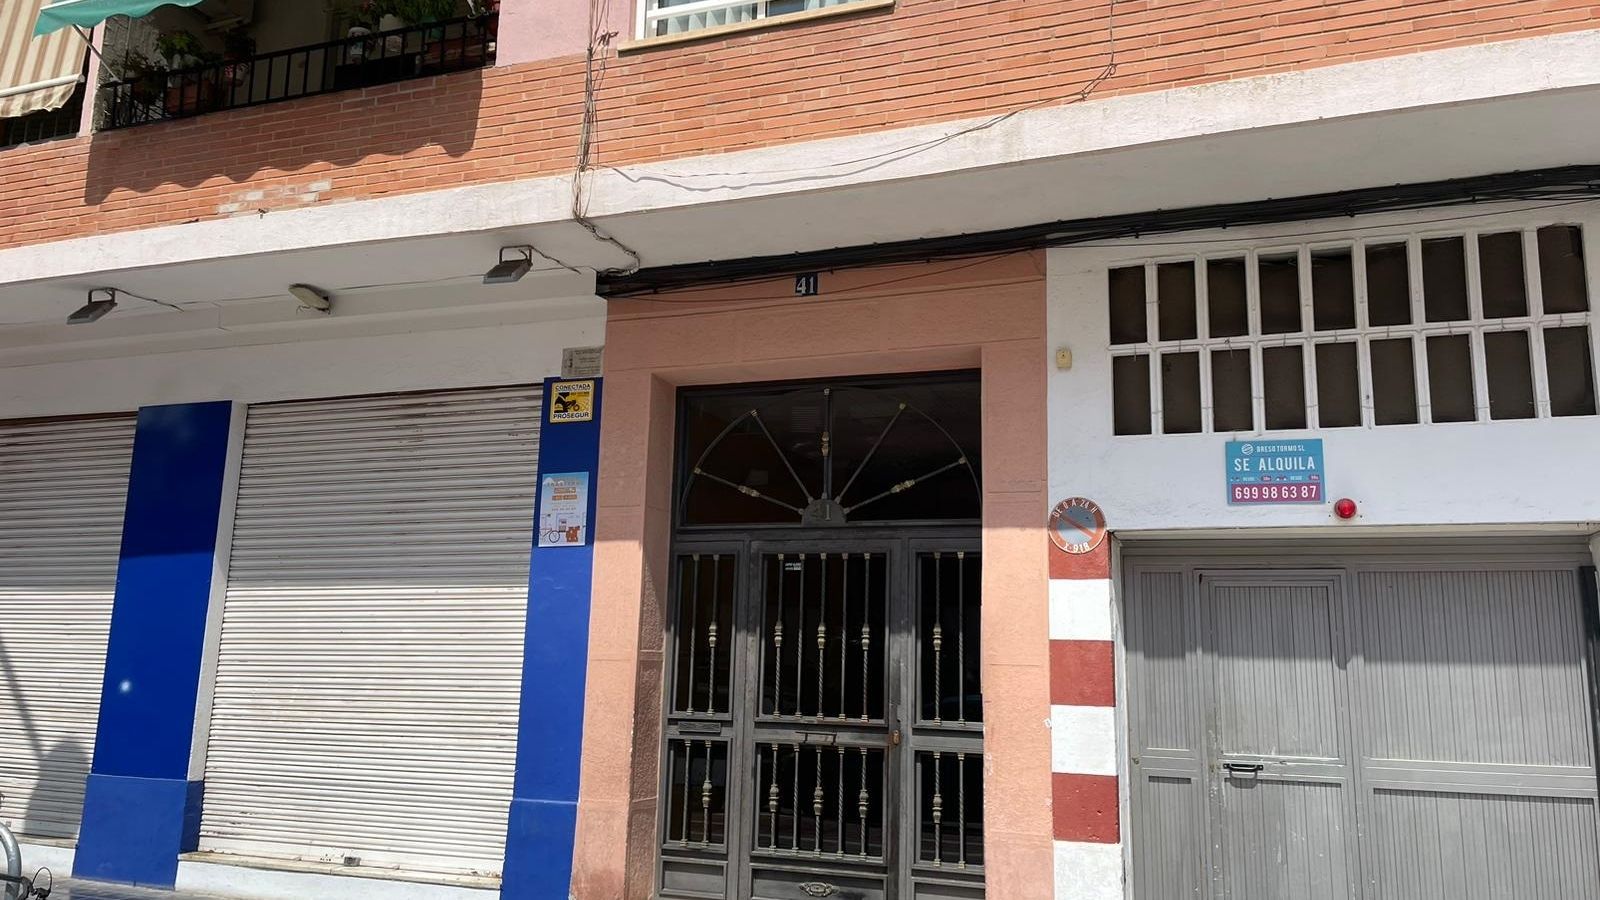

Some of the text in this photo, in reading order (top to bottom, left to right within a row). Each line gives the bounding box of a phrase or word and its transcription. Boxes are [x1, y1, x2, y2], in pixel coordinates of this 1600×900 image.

[796, 276, 815, 294] 41
[555, 383, 591, 391] CONECTADA
[1234, 456, 1315, 471] SE ALQUILA
[1235, 485, 1317, 499] 699 98 63 87
[1052, 507, 1063, 518] DE
[1071, 498, 1077, 507] A
[1080, 499, 1089, 509] 24
[1090, 506, 1098, 514] H
